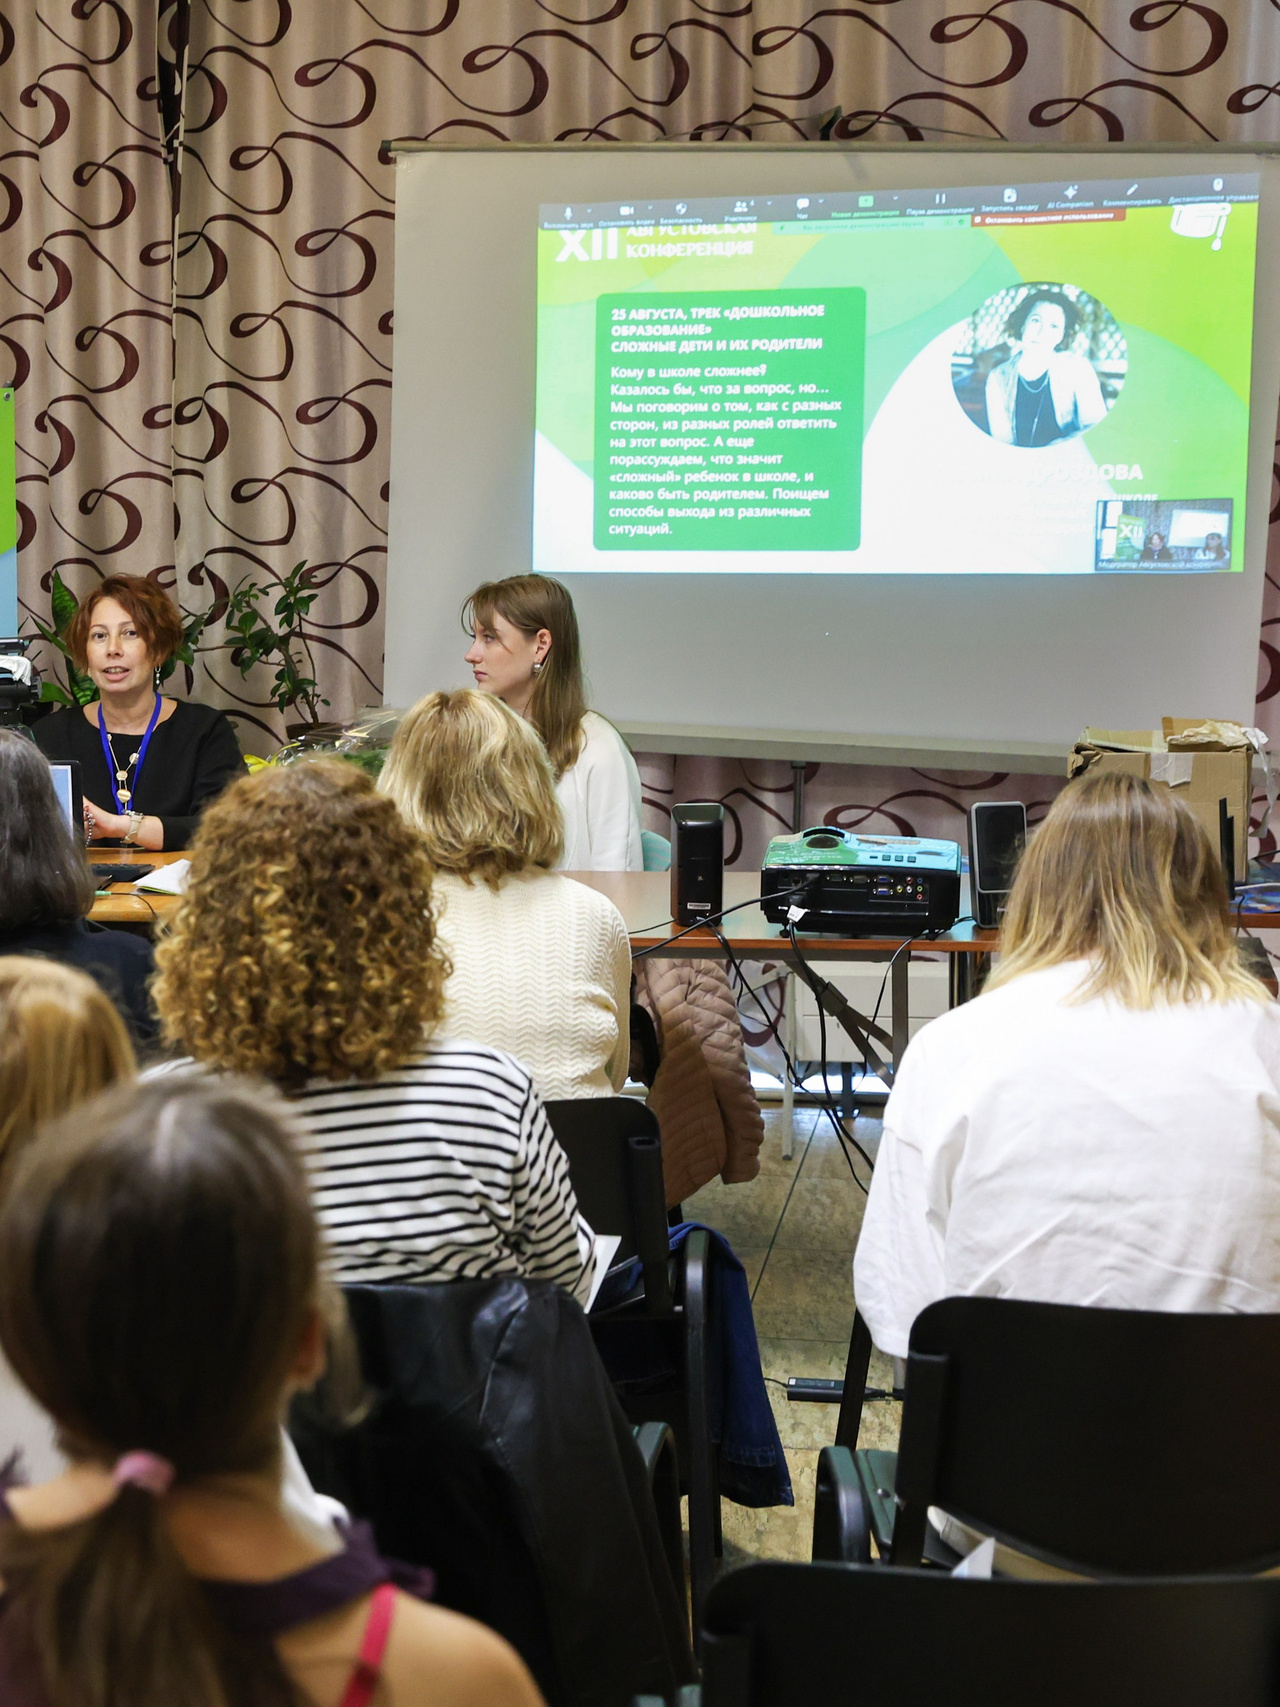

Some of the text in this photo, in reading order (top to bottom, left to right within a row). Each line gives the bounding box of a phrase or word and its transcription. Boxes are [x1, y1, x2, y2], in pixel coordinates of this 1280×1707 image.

[626, 241, 754, 258] КОНФЕРЕНЦИЯ
[612, 305, 825, 321] 25 АВГУСТА, ТРЕК «ДОШКОЛЬНОЕ
[611, 324, 712, 336] ОБРАЗОВАНИЕ»
[611, 338, 822, 354] СЛОЖНЫЕ ДЕТИ И ИХ РОДИТЕЛИ
[611, 364, 766, 380] Кому в школе сложнее?
[611, 385, 669, 395] Казалось
[673, 383, 695, 395] бы,
[699, 385, 722, 393] что
[726, 385, 740, 393] за
[744, 384, 795, 396] вопрос,
[611, 401, 841, 415] Мы поговорим о том, как с разных
[610, 417, 837, 433] сторон, из разных ролей ответить
[610, 436, 754, 449] на этот вопрос. А еще
[610, 454, 783, 467] порассуждаем, что значит
[610, 471, 813, 484] «сложный» ребенок в школе, и
[609, 488, 829, 501] каково быть родителем. Поищем
[609, 506, 811, 519] способы выхода из различных
[609, 524, 672, 537] ситуаций.
